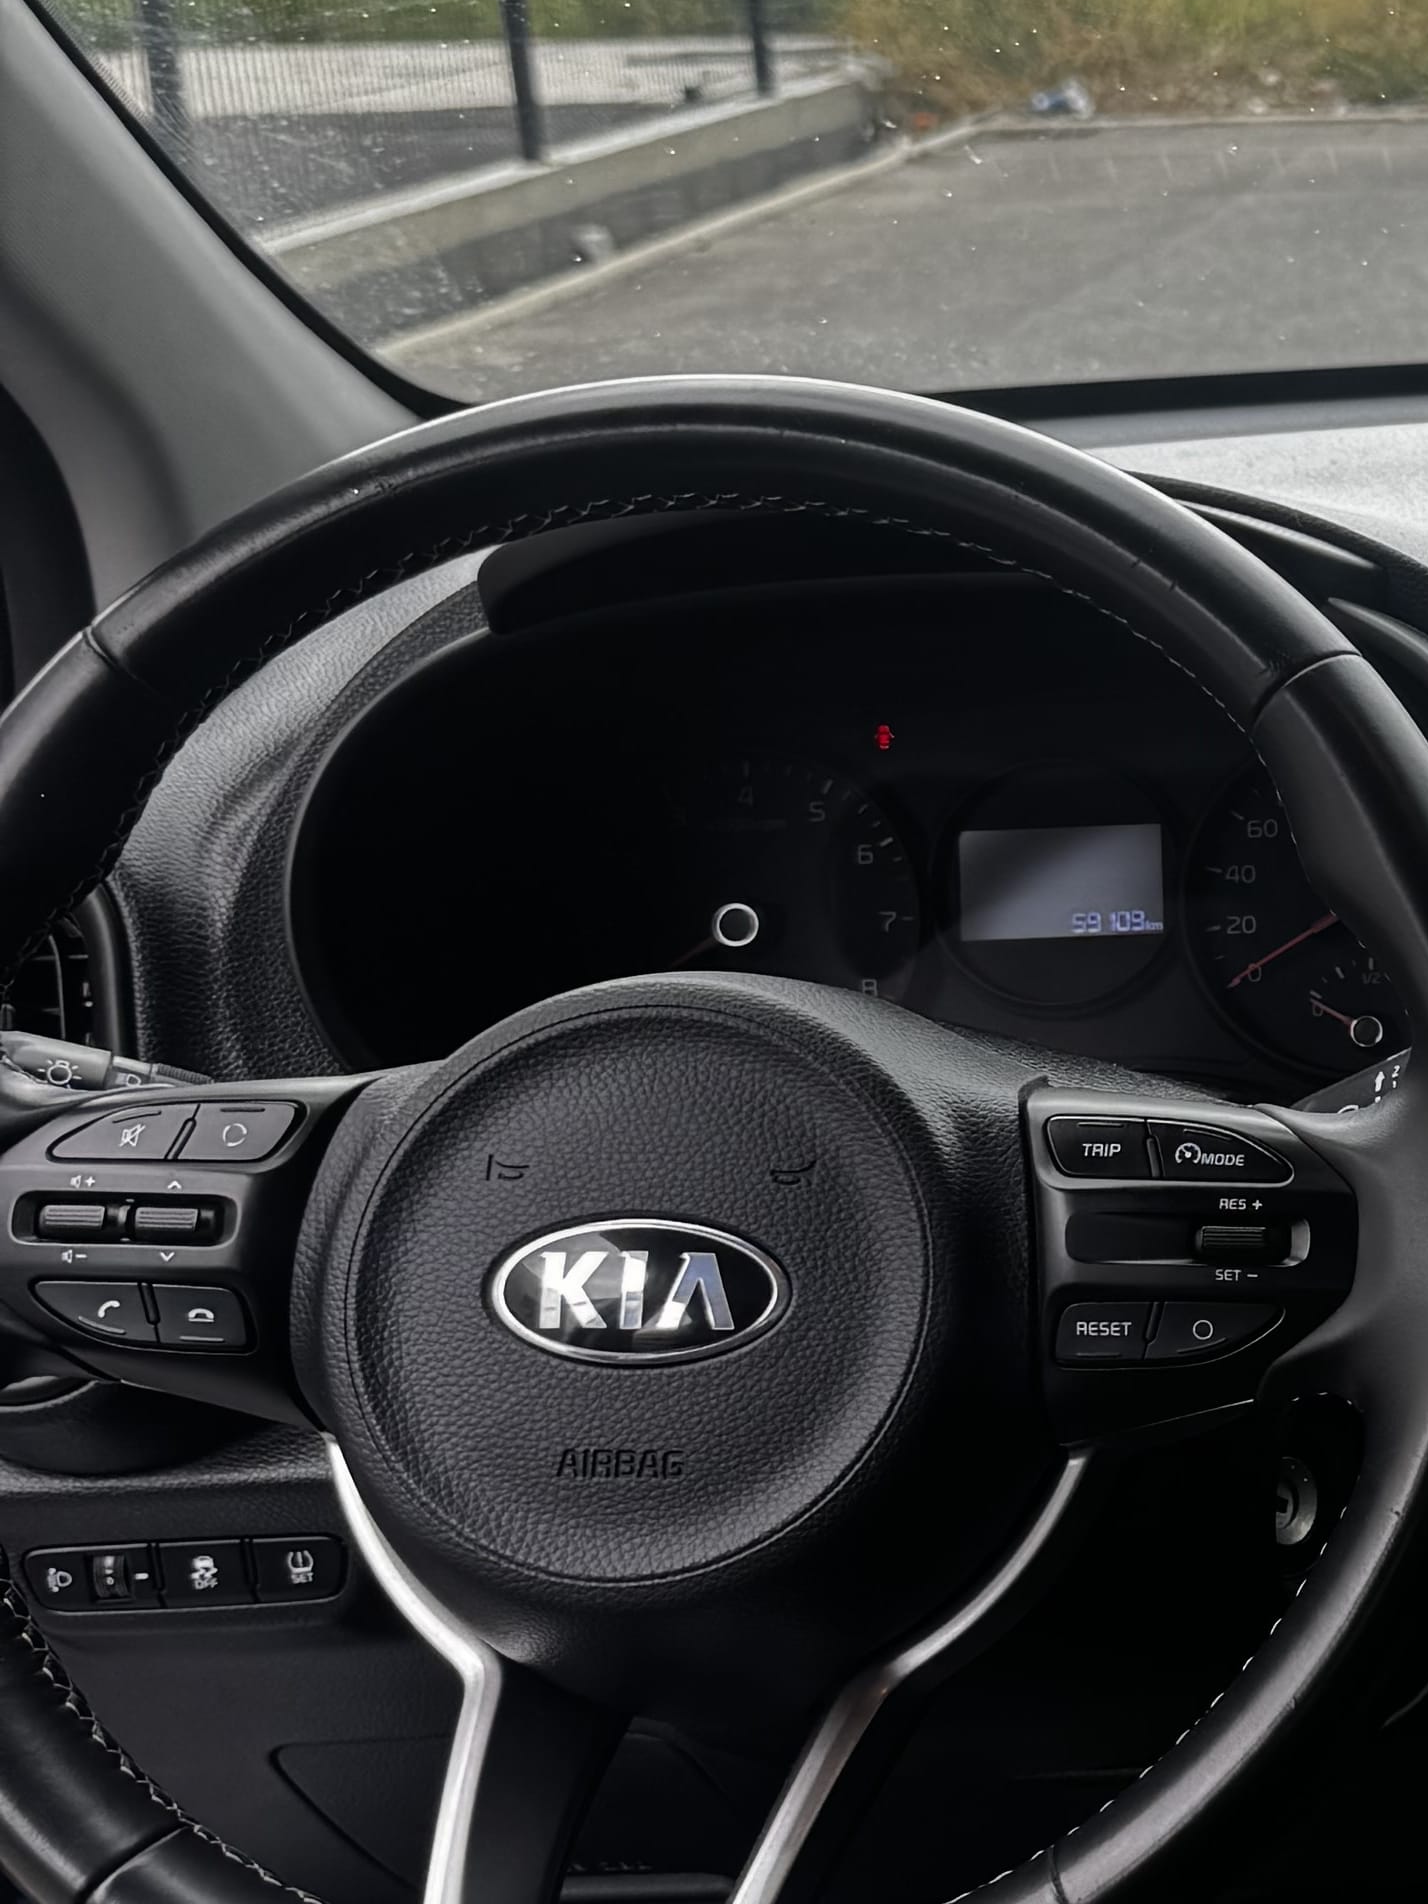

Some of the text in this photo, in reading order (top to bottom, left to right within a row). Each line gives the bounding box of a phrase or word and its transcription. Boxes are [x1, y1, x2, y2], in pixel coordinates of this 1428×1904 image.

[1247, 819, 1279, 839] 60
[857, 843, 874, 865] 6
[1225, 865, 1257, 884] 40
[877, 911, 897, 933] 7
[1225, 915, 1257, 935] 20
[1082, 1143, 1122, 1158] TRIP
[1200, 1152, 1246, 1167] MODE
[1219, 1197, 1247, 1211] RES
[1215, 1269, 1242, 1282] SET
[538, 1250, 736, 1331] KIA
[1076, 1321, 1133, 1337] RESET
[556, 1448, 685, 1480] AIRBAG
